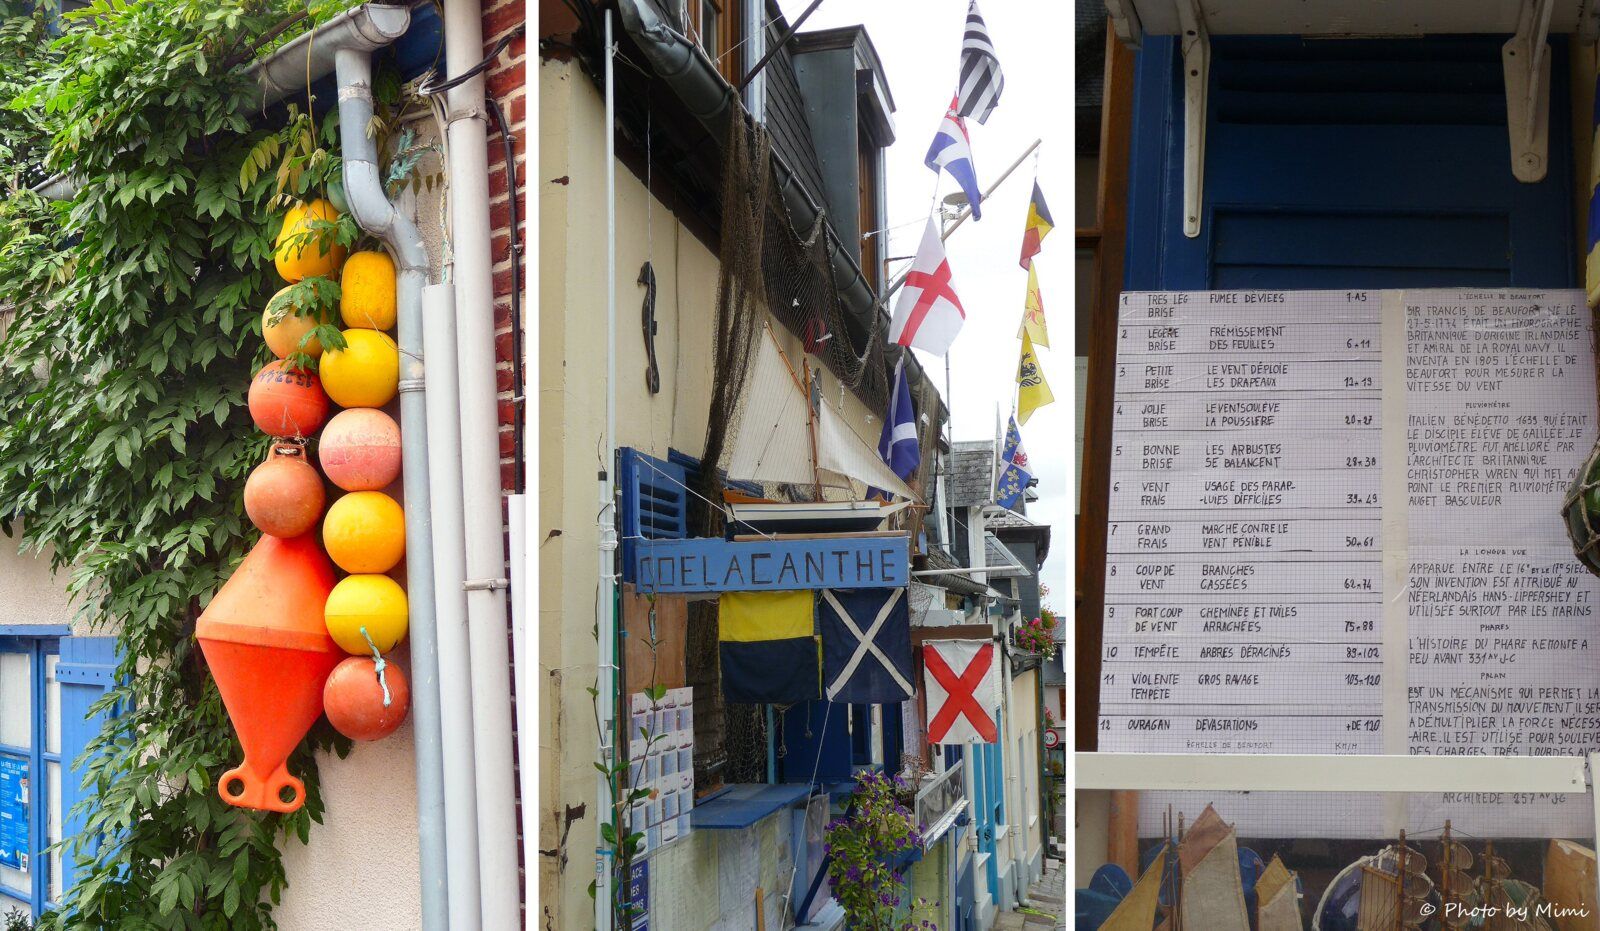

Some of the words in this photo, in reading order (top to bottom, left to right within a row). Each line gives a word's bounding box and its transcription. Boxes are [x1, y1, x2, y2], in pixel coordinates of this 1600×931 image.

[1148, 307, 1174, 317] BRISE
[1407, 306, 1420, 316] SIR
[1428, 304, 1466, 315] FRANCIS
[1475, 306, 1485, 315] DE
[1566, 305, 1577, 315] LE
[1122, 330, 1127, 338] 2
[1525, 328, 1580, 340] IRLANDAISE
[1149, 340, 1175, 350] BRISE
[1210, 340, 1228, 349] DES
[1233, 339, 1274, 349] FEUILLES
[1408, 344, 1419, 353] ET
[1423, 342, 1454, 353] AMIRAL
[1461, 344, 1471, 353] DE
[1477, 343, 1488, 353] LA
[1493, 343, 1520, 353] ROYAL
[1407, 356, 1448, 366] INVENTA
[1455, 357, 1469, 365] EN
[1476, 356, 1498, 365] 1805
[1566, 355, 1577, 364] DE
[1120, 368, 1125, 376] 3
[1146, 366, 1173, 376] PETITE
[1208, 366, 1218, 374] LE
[1221, 365, 1248, 375] VENT
[1407, 369, 1457, 378] BEAUFORT
[1465, 369, 1489, 378] POUR
[1496, 368, 1544, 378] MESURER
[1553, 368, 1564, 377] LA
[1145, 379, 1169, 388] BRISE
[1207, 379, 1225, 388] LES
[1231, 378, 1276, 387] DRAPEAUX
[1407, 380, 1451, 392] VITESSE
[1457, 381, 1470, 391] DU
[1477, 381, 1502, 391] VENT
[1117, 405, 1122, 415] 4
[1142, 404, 1166, 414] JOLIE
[1143, 417, 1168, 427] BRISE
[1206, 417, 1216, 426] LA
[1409, 414, 1445, 426] ITALIEN
[1408, 429, 1419, 439] LE
[1425, 426, 1466, 439] DISCIPLE
[1507, 429, 1519, 439] DE
[1570, 429, 1582, 438] LE
[1116, 446, 1122, 455] 5
[1143, 444, 1180, 455] BONNE
[1206, 444, 1223, 455] LES
[1231, 444, 1281, 455] ARBUSTES
[1483, 442, 1499, 452] FUT
[1557, 442, 1575, 452] PAR
[1143, 458, 1173, 468] BRISE
[1205, 458, 1218, 468] SE
[1225, 457, 1281, 468] BALANCENT
[1408, 453, 1475, 466] L'ARCHITECTE
[1483, 453, 1547, 465] BRITANNIQUE
[1408, 467, 1479, 480] CHRISTOPHER
[1486, 469, 1517, 479] WREN
[1545, 469, 1561, 479] MET
[1114, 482, 1119, 491] 6
[1142, 482, 1169, 492] VENT
[1205, 481, 1235, 491] USAGE
[1241, 481, 1259, 491] DES
[1408, 480, 1433, 493] POINT
[1441, 482, 1450, 492] LE
[1458, 480, 1502, 493] PREMIER
[1141, 494, 1165, 505] FRAIS
[1234, 492, 1282, 504] DIFFICILES
[1409, 496, 1436, 506] AUGET
[1446, 495, 1502, 506] BASCULEUR
[1112, 525, 1118, 535] 7
[1138, 525, 1170, 535] GRAND
[1202, 524, 1238, 533] MARCHE
[1242, 524, 1275, 533] CONTRE
[1278, 524, 1288, 532] LE
[1138, 538, 1167, 548] FRAIS
[1203, 538, 1228, 548] VENT
[1111, 565, 1116, 576] 8
[1136, 565, 1162, 575] COUP
[1164, 565, 1174, 575] DE
[1202, 565, 1254, 576] BRANCHES
[1409, 563, 1455, 574] APPARUE
[1463, 563, 1494, 573] ENTRE
[1500, 563, 1513, 574] LE
[1140, 579, 1165, 589] VENT
[1410, 577, 1430, 588] SON
[1435, 574, 1487, 588] INVENTION
[1494, 576, 1510, 588] EST
[1567, 577, 1578, 588] AU
[1577, 591, 1590, 602] ET
[1109, 607, 1114, 618] 9
[1136, 608, 1158, 618] FORT
[1161, 608, 1182, 617] COUP
[1254, 607, 1266, 617] ET
[1459, 605, 1502, 616] SURTOUT
[1509, 605, 1527, 616] PAR
[1532, 606, 1547, 616] LES
[1553, 603, 1592, 617] MARINS
[1136, 622, 1147, 632] DE
[1151, 622, 1177, 632] VENT
[1480, 624, 1509, 632] PHARES
[1409, 636, 1468, 650] L'HISTOIRE
[1475, 638, 1488, 649] DU
[1494, 639, 1527, 650] PHARE
[1532, 639, 1577, 650] REMONTE
[1107, 647, 1117, 657] 10
[1200, 647, 1233, 657] ARBRES
[1410, 653, 1428, 664] PEU
[1434, 653, 1463, 664] AVANT
[1104, 674, 1114, 685] 11
[1132, 672, 1179, 684] VIOLENTE
[1198, 674, 1220, 684] GROS
[1226, 674, 1258, 684] RAVAGE
[1430, 687, 1443, 698] UN
[1539, 687, 1581, 699] PERMET
[1589, 688, 1599, 699] LA
[1409, 699, 1486, 713] TRANSMISSION
[1492, 702, 1503, 713] DU
[1508, 702, 1573, 713] MOUVEMENT
[1100, 720, 1110, 730] 12
[1128, 719, 1170, 729] OURAGAN
[1364, 721, 1380, 730] 120
[1503, 717, 1514, 727] LA
[1520, 717, 1554, 728] FORCE
[1456, 732, 1476, 743] EST
[1529, 732, 1554, 744] POUR
[1436, 746, 1486, 756] CHARGES
[1529, 746, 1573, 756] LOURDES
